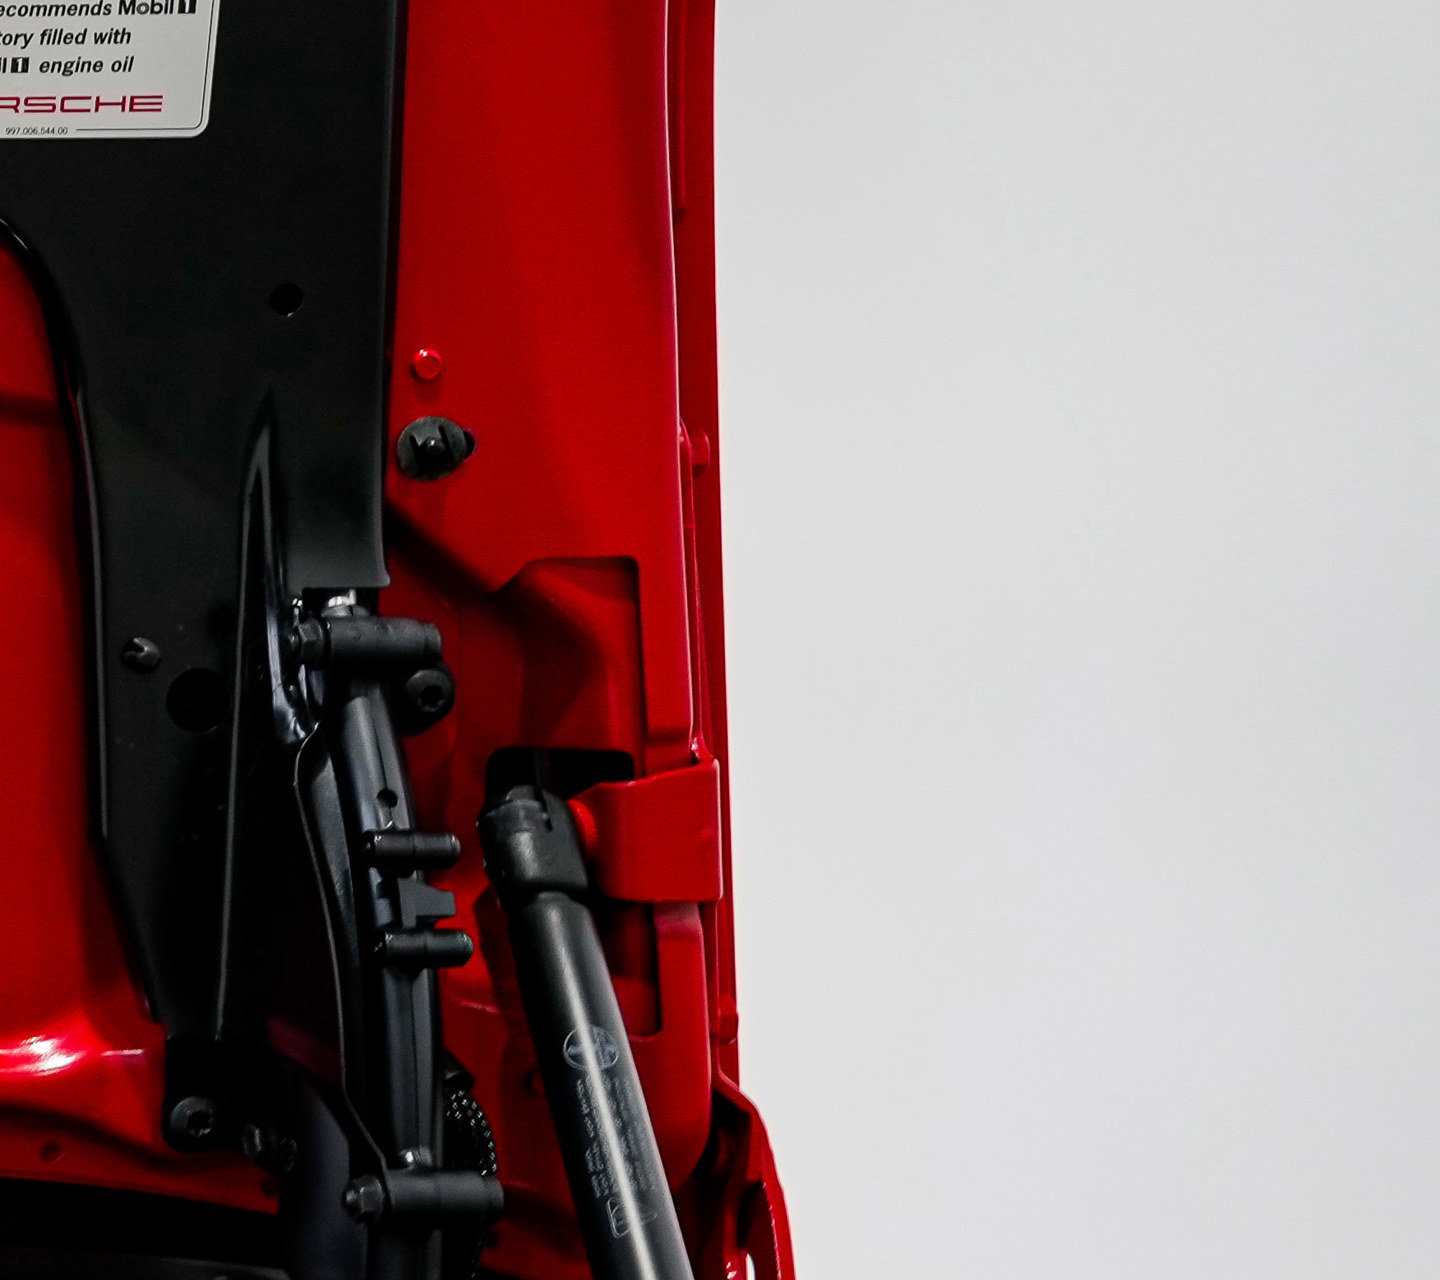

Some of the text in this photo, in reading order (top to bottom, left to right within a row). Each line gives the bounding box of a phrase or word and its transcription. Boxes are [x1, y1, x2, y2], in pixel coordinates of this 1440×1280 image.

[40, 28, 88, 45] filled
[94, 27, 131, 45] with
[39, 56, 103, 77] engine
[111, 55, 134, 73] oil
